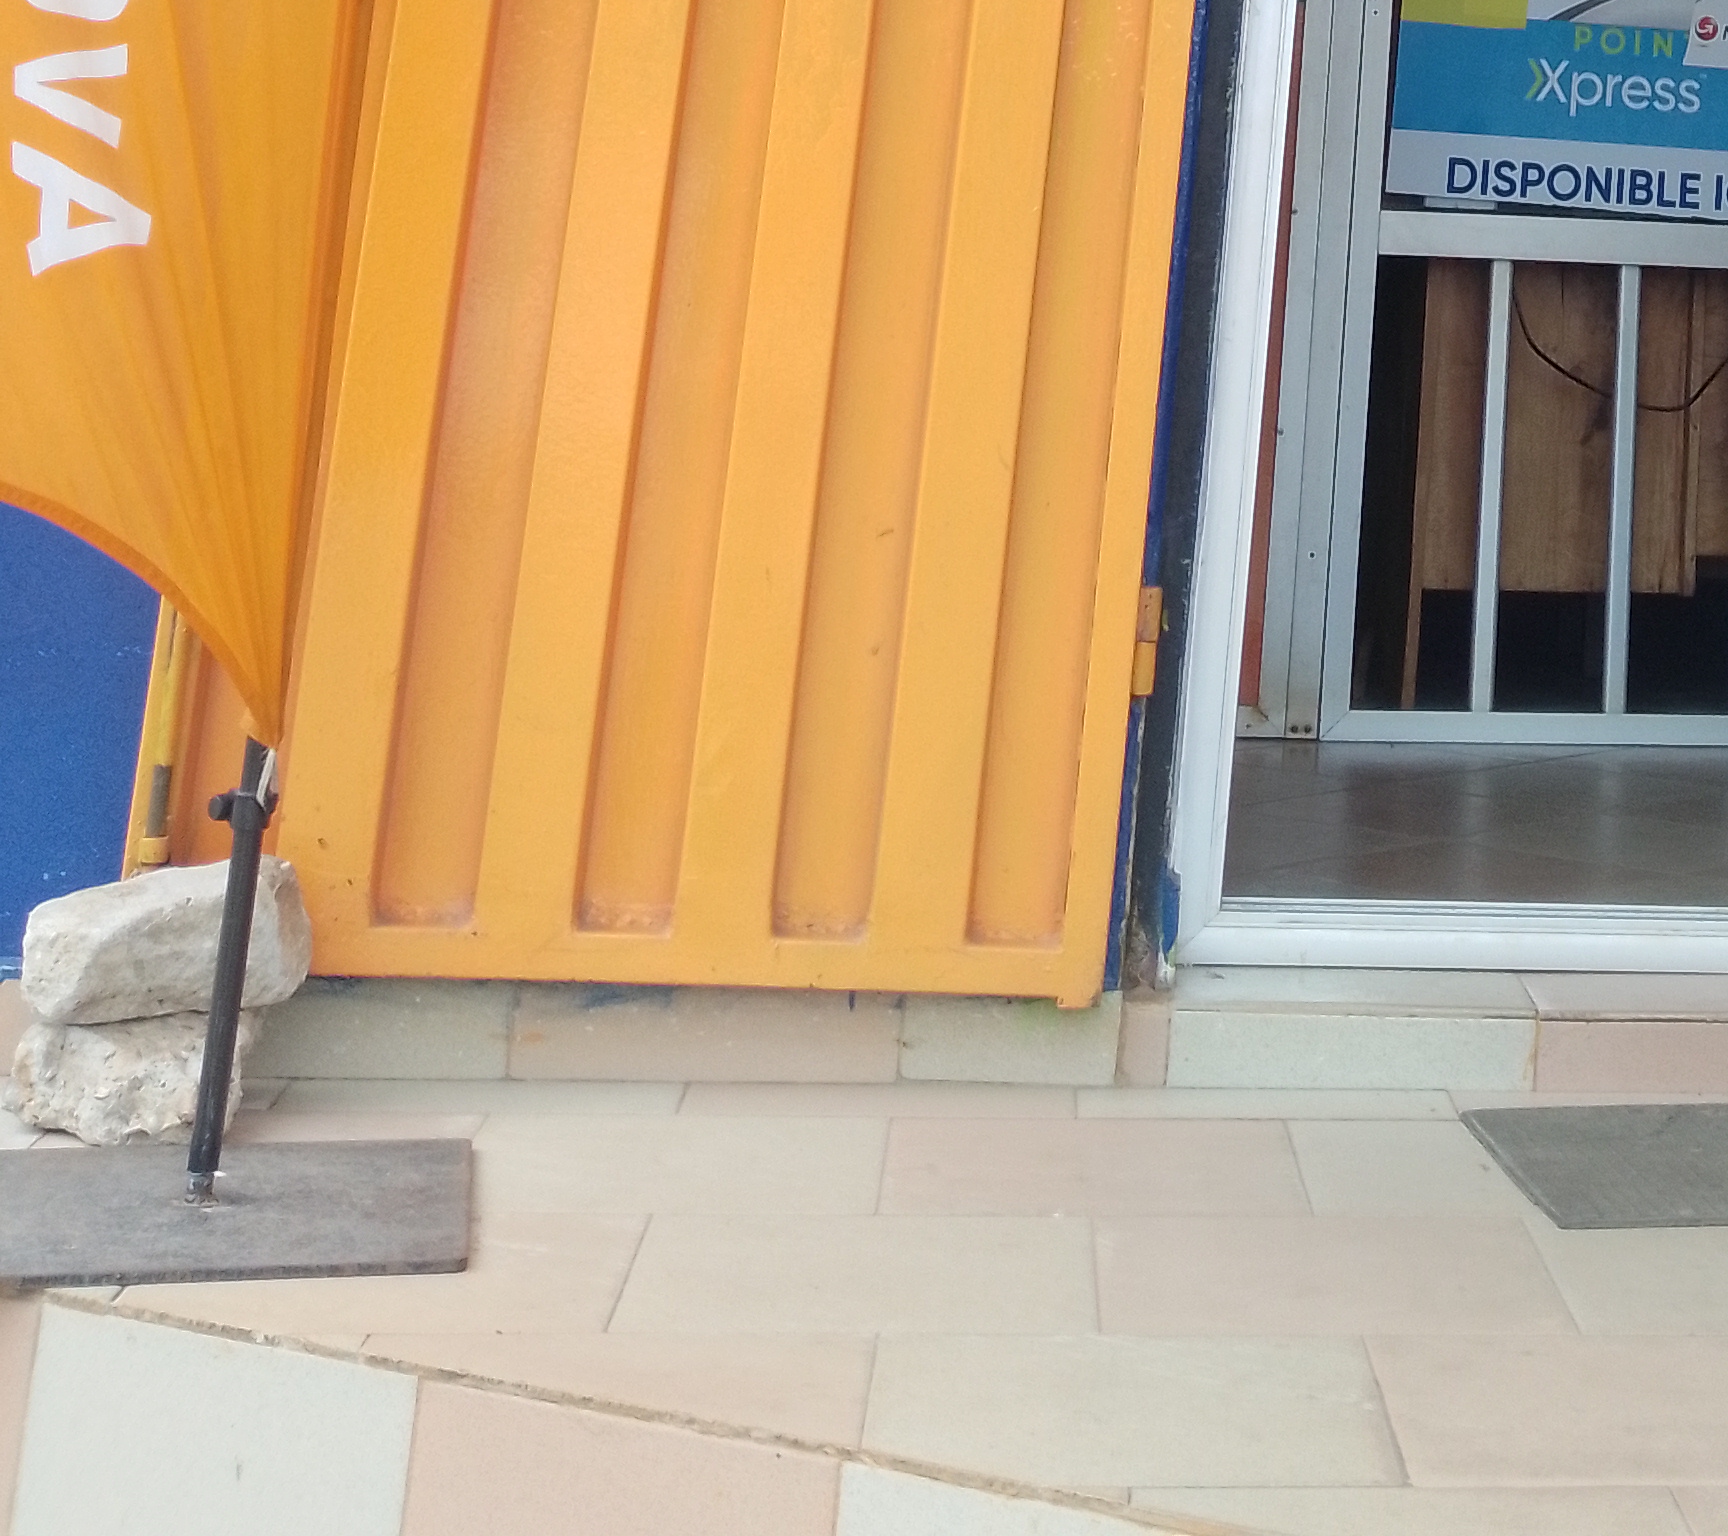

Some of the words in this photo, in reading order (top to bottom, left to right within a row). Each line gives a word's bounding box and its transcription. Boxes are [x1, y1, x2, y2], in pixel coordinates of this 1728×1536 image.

[1573, 25, 1690, 58] POIN
[1535, 58, 1703, 118] Xpress
[1445, 155, 1703, 210] DISPONIBLE
